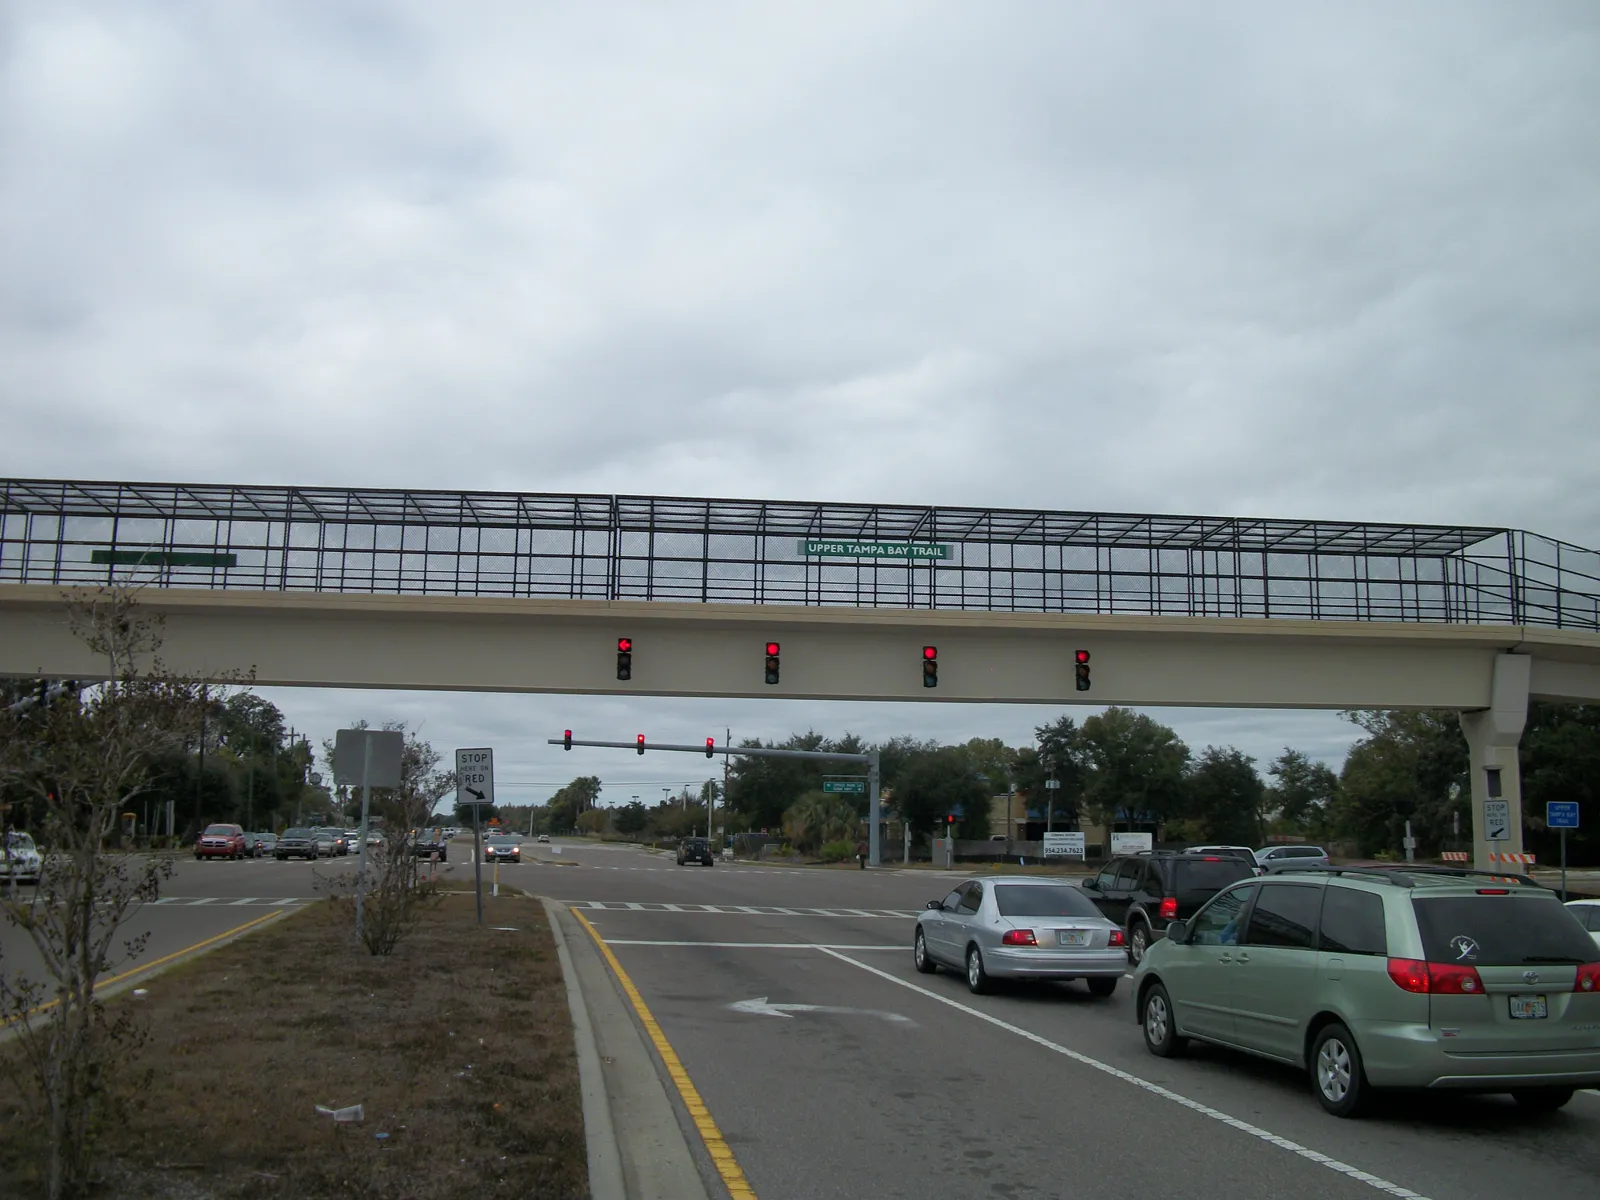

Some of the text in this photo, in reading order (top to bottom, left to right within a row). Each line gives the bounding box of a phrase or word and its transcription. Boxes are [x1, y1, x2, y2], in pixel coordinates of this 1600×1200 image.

[808, 543, 944, 557] UPPER TAMPA BAY TRAIL
[461, 753, 488, 763] STOP
[465, 774, 485, 783] RED
[1489, 818, 1504, 826] RED
